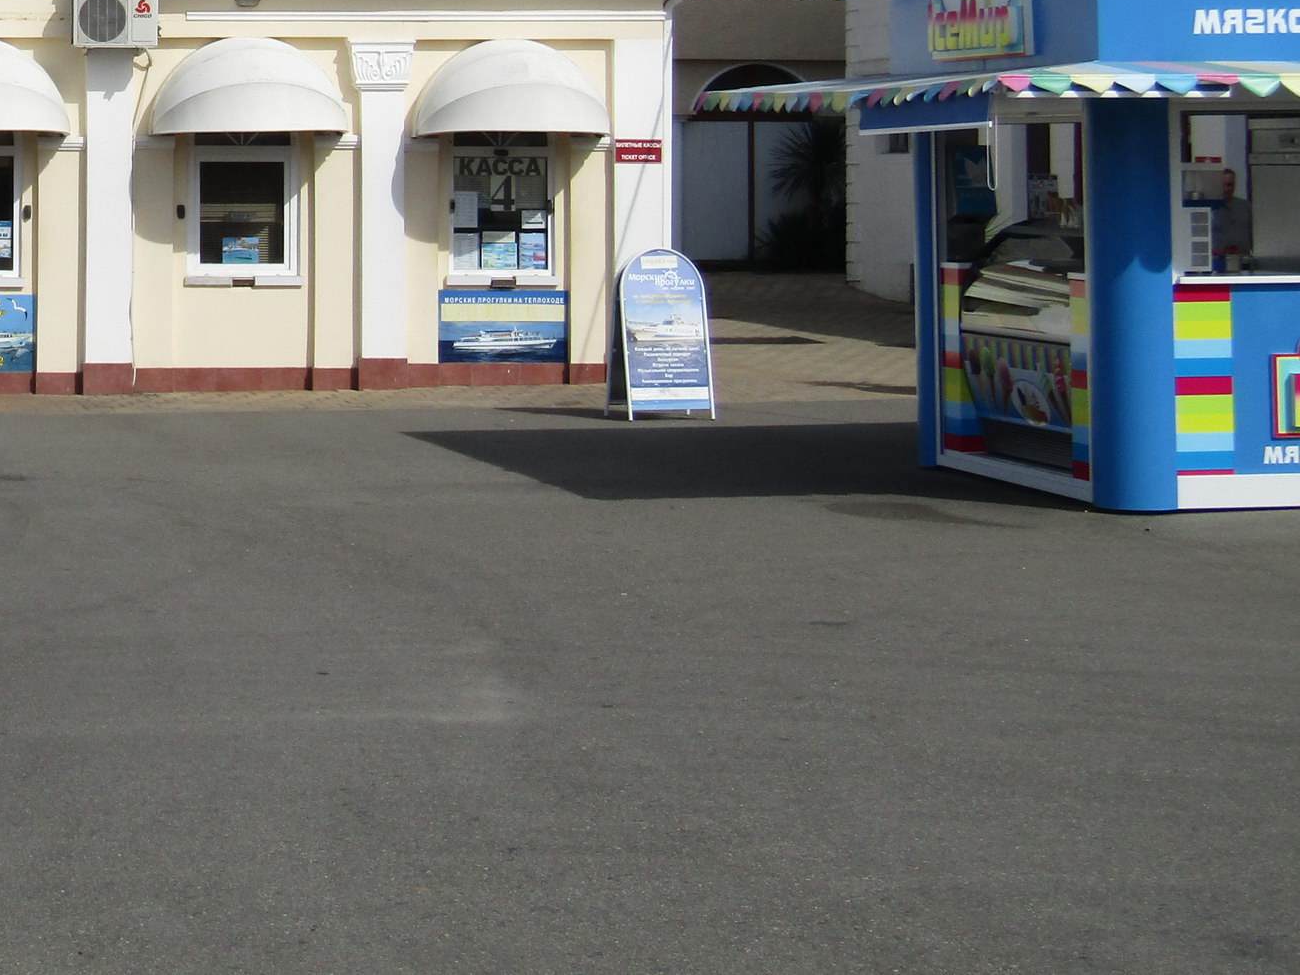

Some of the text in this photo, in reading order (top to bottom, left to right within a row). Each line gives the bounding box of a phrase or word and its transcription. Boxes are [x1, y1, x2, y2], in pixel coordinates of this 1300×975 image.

[460, 157, 542, 176] КАССА
[491, 175, 515, 211] 4
[628, 274, 665, 283] Морские
